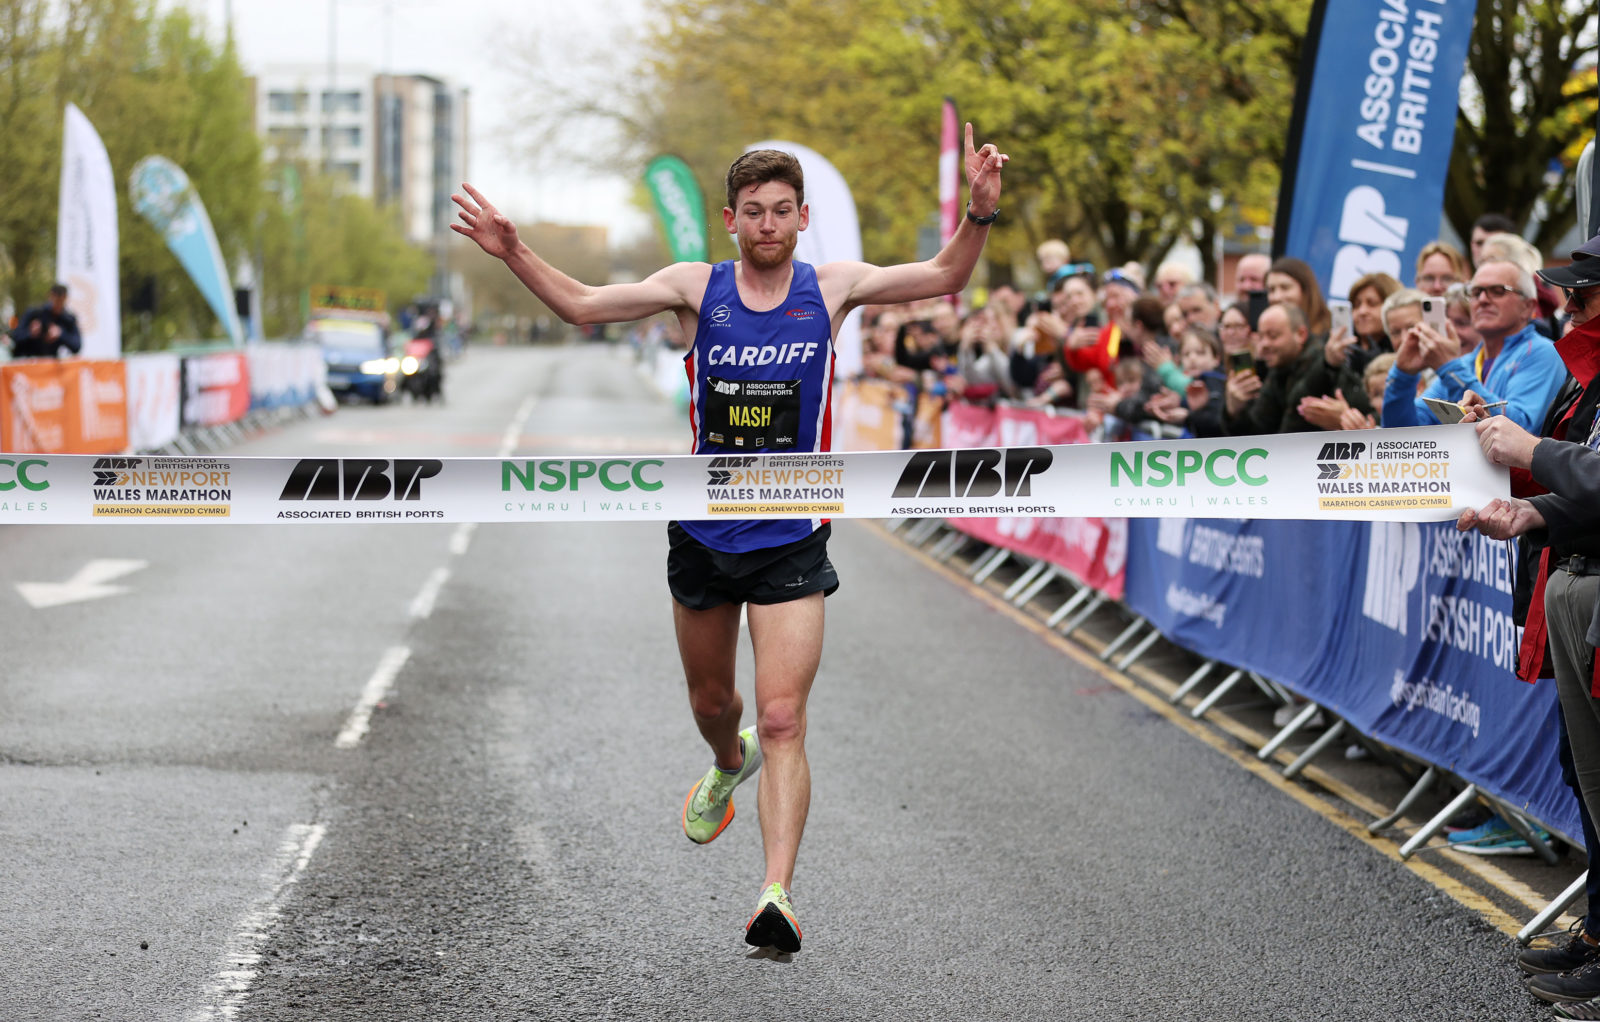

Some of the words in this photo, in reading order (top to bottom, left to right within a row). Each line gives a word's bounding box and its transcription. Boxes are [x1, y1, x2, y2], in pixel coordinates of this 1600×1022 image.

[1391, 9, 1443, 155] BRITISH
[708, 342, 818, 366] CARDIFF
[714, 380, 740, 395] ABP
[729, 405, 772, 427] NASH
[1317, 442, 1366, 460] ABP
[1376, 441, 1437, 450] ASSOCIATED
[707, 456, 759, 468] ABP
[1376, 451, 1414, 459] BRITISH
[1417, 451, 1449, 459] PORTS
[93, 458, 142, 469] ABP
[1110, 448, 1269, 487] NSPCC
[1355, 462, 1450, 479] NEWPORT
[132, 471, 231, 486] NEWPORT
[279, 459, 443, 500] ABP
[501, 460, 664, 492] NSPCC
[746, 469, 844, 485] NEWPORT
[891, 448, 1054, 498] ABP
[93, 489, 141, 500] WALES
[146, 489, 231, 500] MARATHON
[707, 488, 754, 500] WALES
[760, 488, 844, 499] MARATHON
[1317, 482, 1364, 494] WALES
[1368, 482, 1451, 493] MARATHON
[505, 502, 570, 512] CYMRU
[600, 502, 664, 511] WALES
[1114, 497, 1178, 506] CYMRU
[1207, 496, 1269, 505] WALES
[1369, 499, 1418, 507] CASNEWYDD
[891, 507, 965, 515] ASSOCIATED
[968, 506, 1014, 514] BRITISH
[1483, 606, 1524, 673] POR
